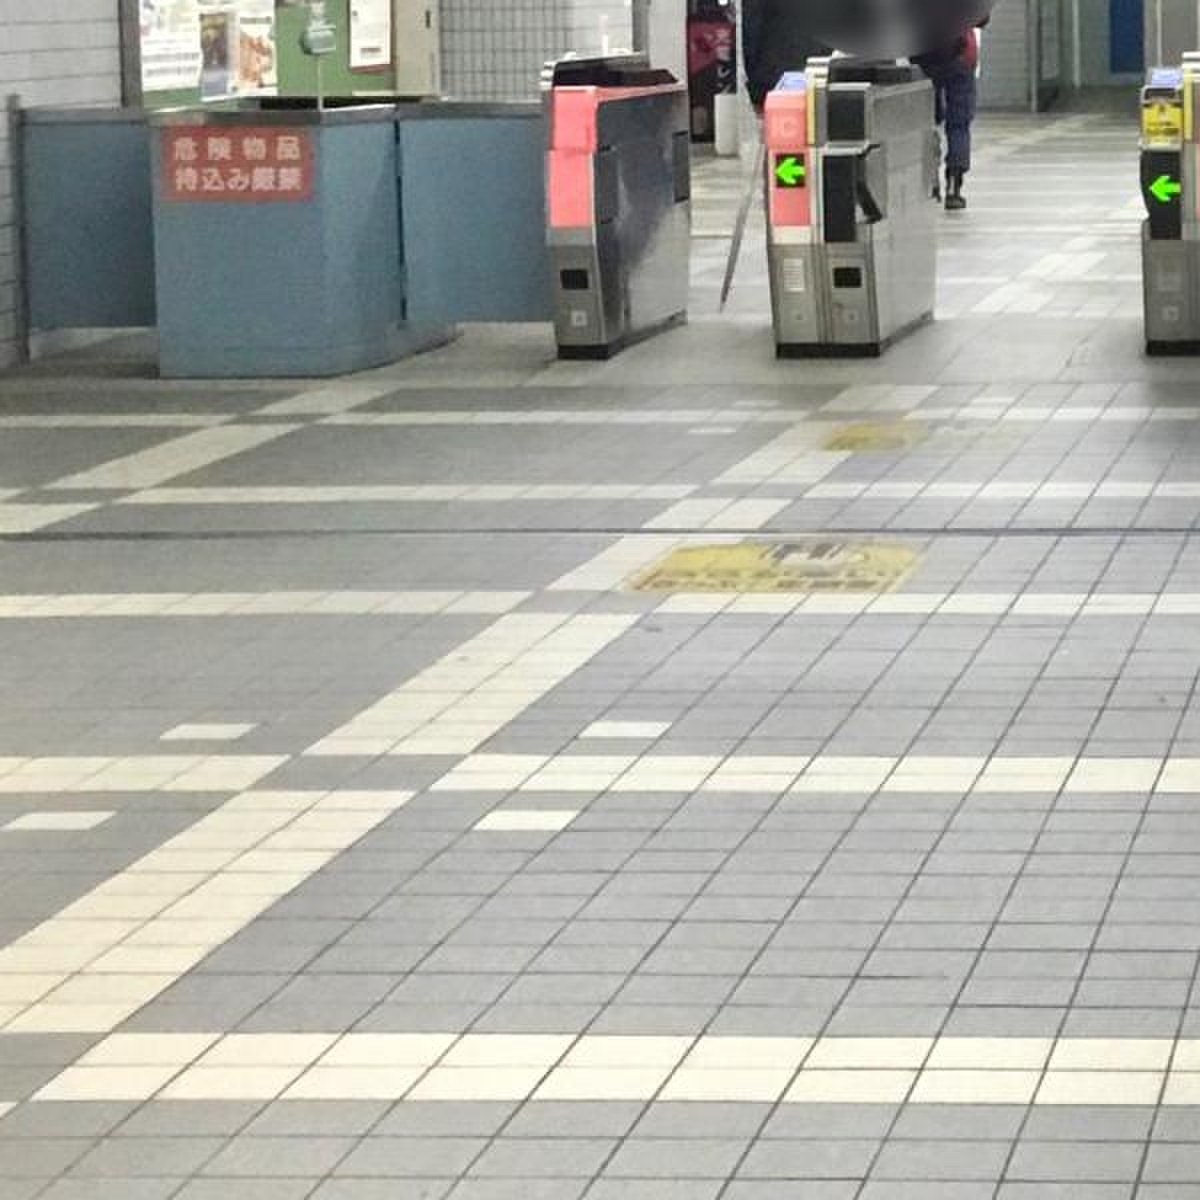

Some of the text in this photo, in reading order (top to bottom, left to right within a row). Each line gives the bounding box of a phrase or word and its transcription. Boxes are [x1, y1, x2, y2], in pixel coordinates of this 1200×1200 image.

[770, 115, 798, 138] IC
[173, 136, 300, 161] 危険物品
[175, 167, 302, 191] 持込み厳禁
